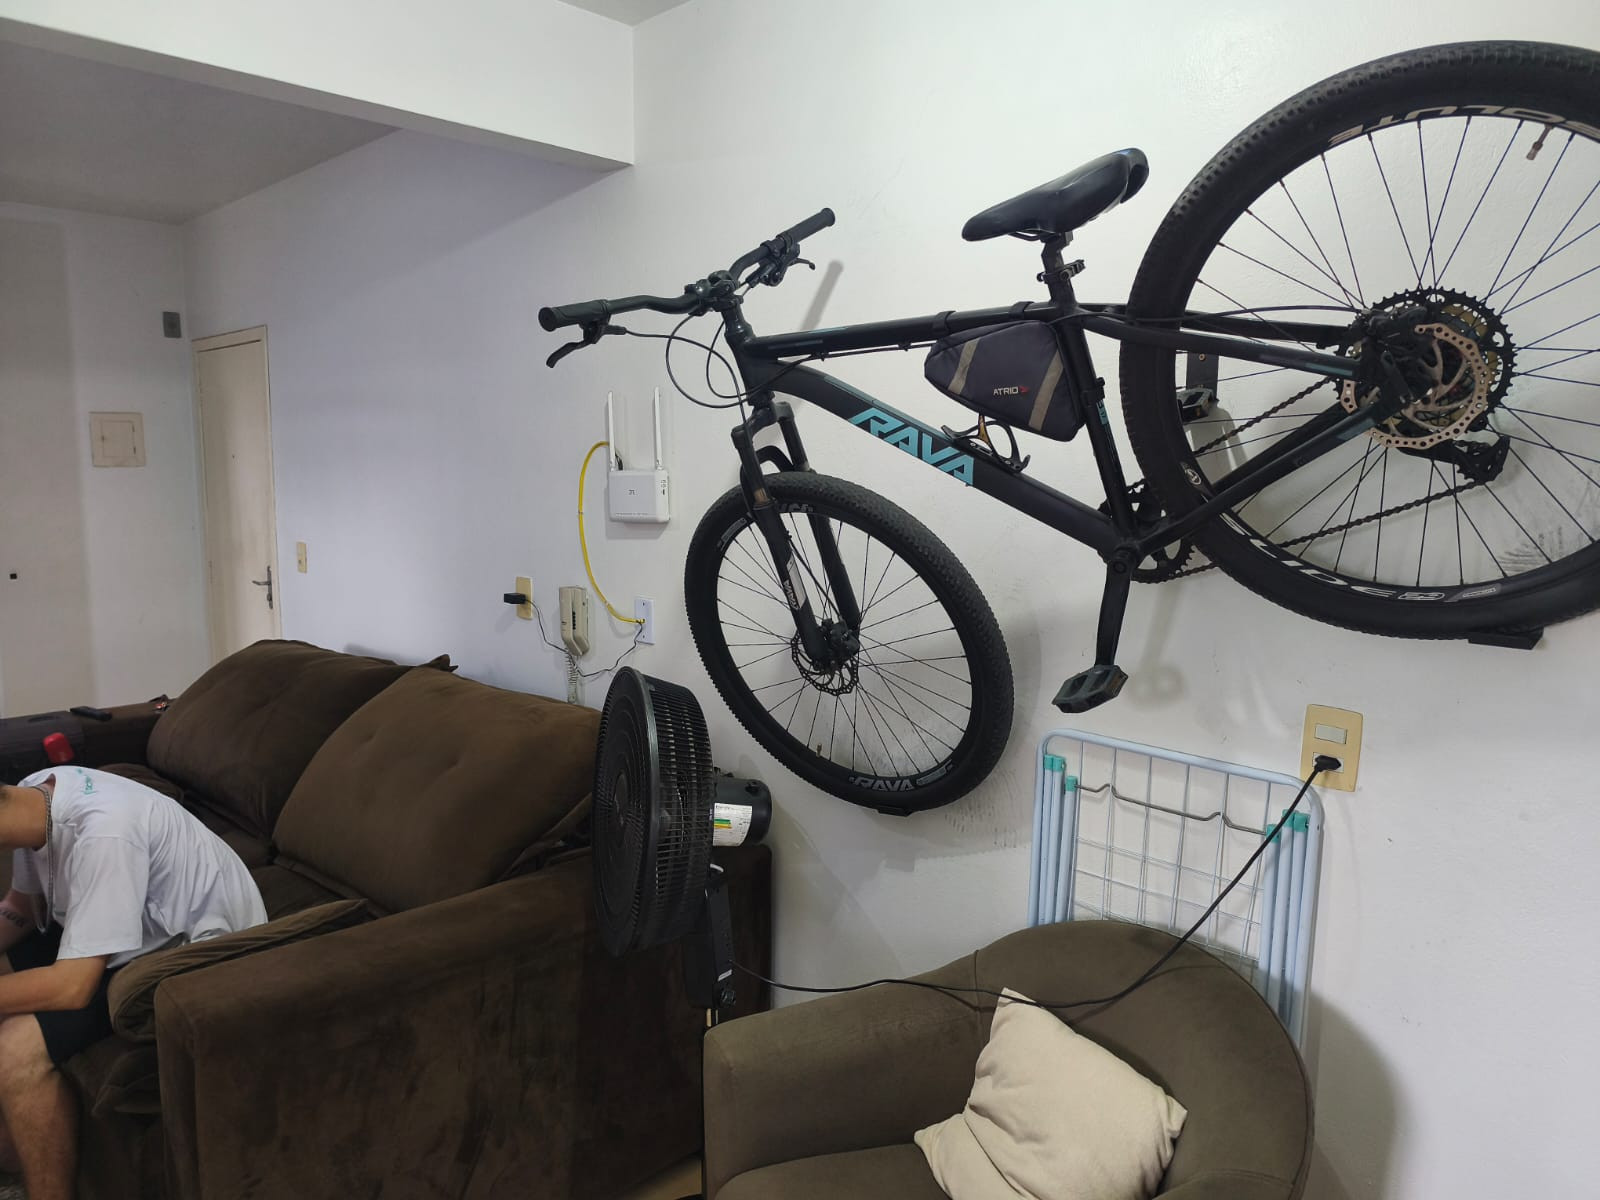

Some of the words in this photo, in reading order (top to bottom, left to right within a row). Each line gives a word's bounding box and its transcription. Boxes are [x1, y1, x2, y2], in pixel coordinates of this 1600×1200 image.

[993, 386, 1019, 396] ATRIO
[849, 407, 974, 486] RAVA
[855, 776, 916, 793] RAVA
